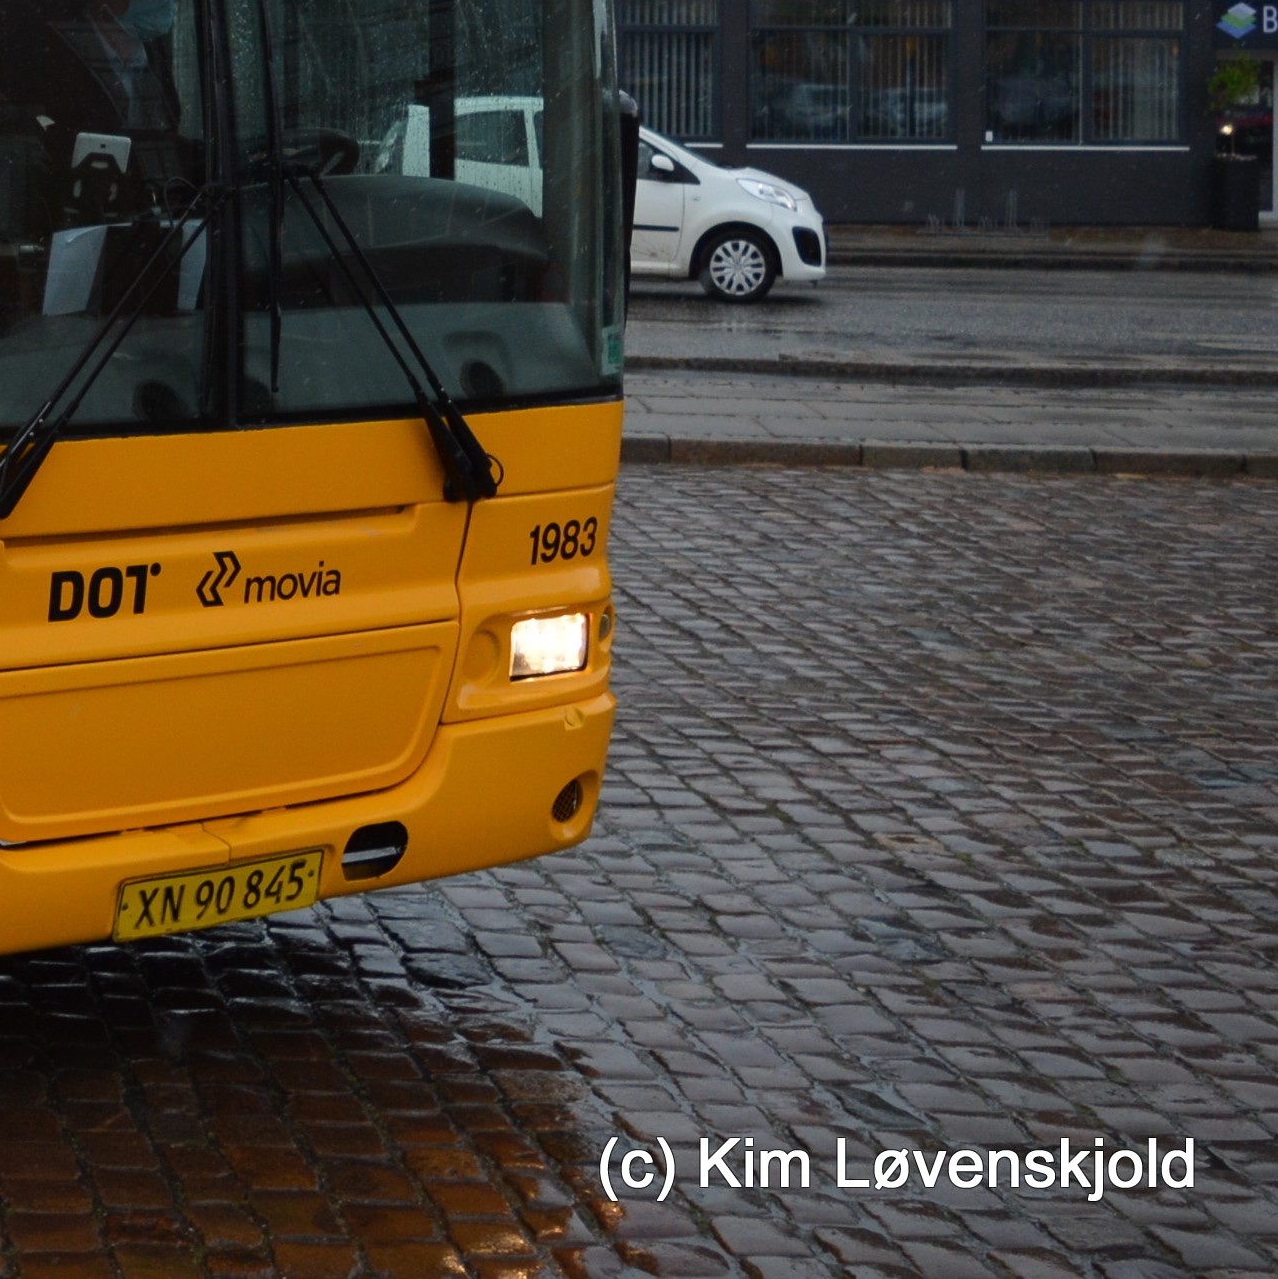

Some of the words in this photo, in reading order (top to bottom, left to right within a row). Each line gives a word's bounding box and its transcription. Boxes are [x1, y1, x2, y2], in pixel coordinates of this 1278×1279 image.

[529, 516, 598, 566] 1983
[47, 561, 161, 623] DOT
[243, 560, 342, 604] movia
[134, 884, 186, 930] XN
[196, 876, 236, 921] 90
[243, 858, 308, 910] 845
